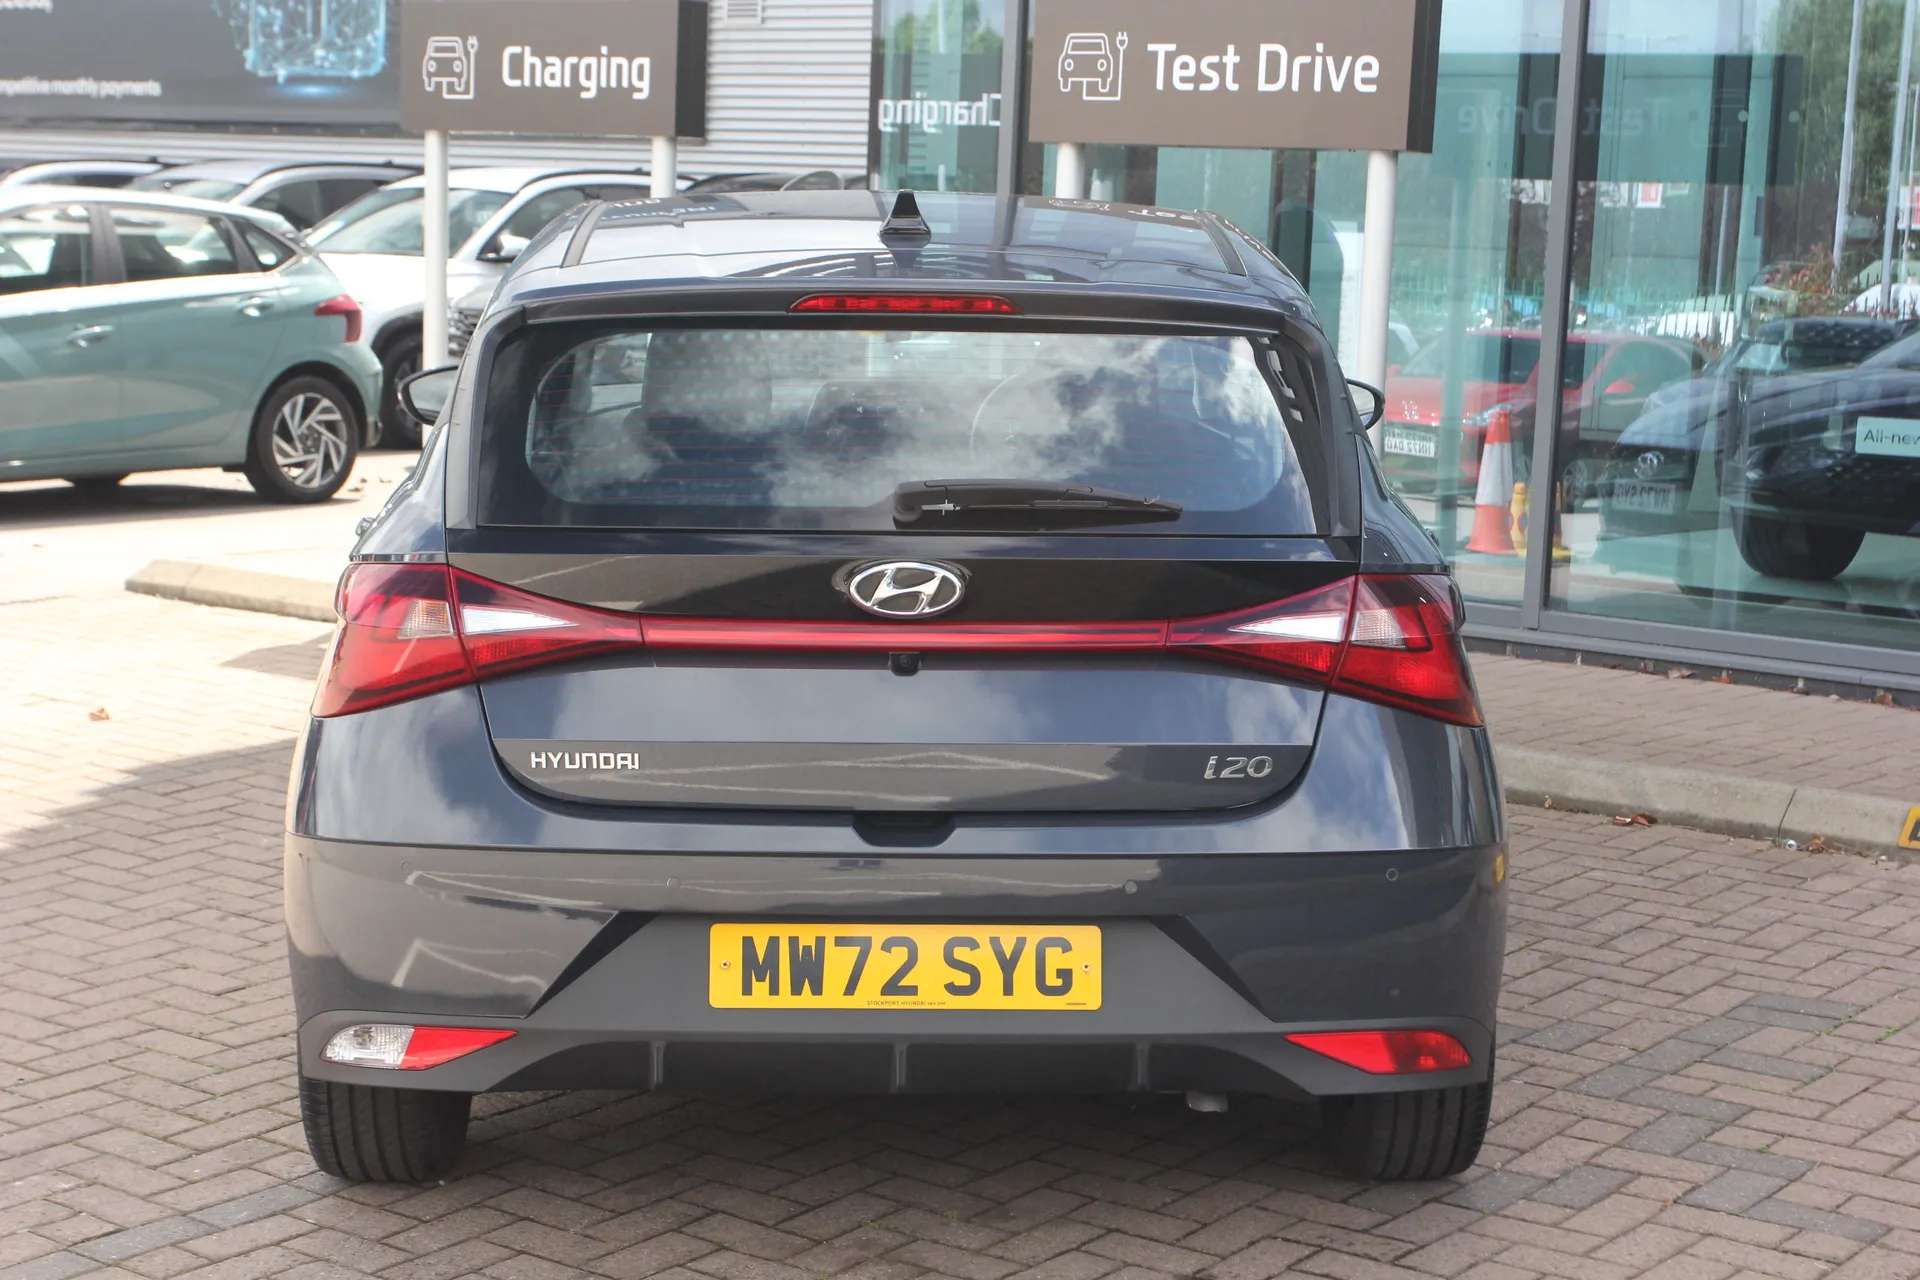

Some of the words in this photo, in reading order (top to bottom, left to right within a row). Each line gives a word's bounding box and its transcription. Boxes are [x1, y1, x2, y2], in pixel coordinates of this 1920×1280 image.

[100, 78, 162, 98] payments
[502, 45, 650, 100] Charging
[1147, 43, 1241, 92] Test
[1257, 42, 1380, 93] Drive
[530, 751, 640, 770] HYUNDAI
[741, 935, 919, 997] MW72
[943, 936, 1074, 997] SYG
